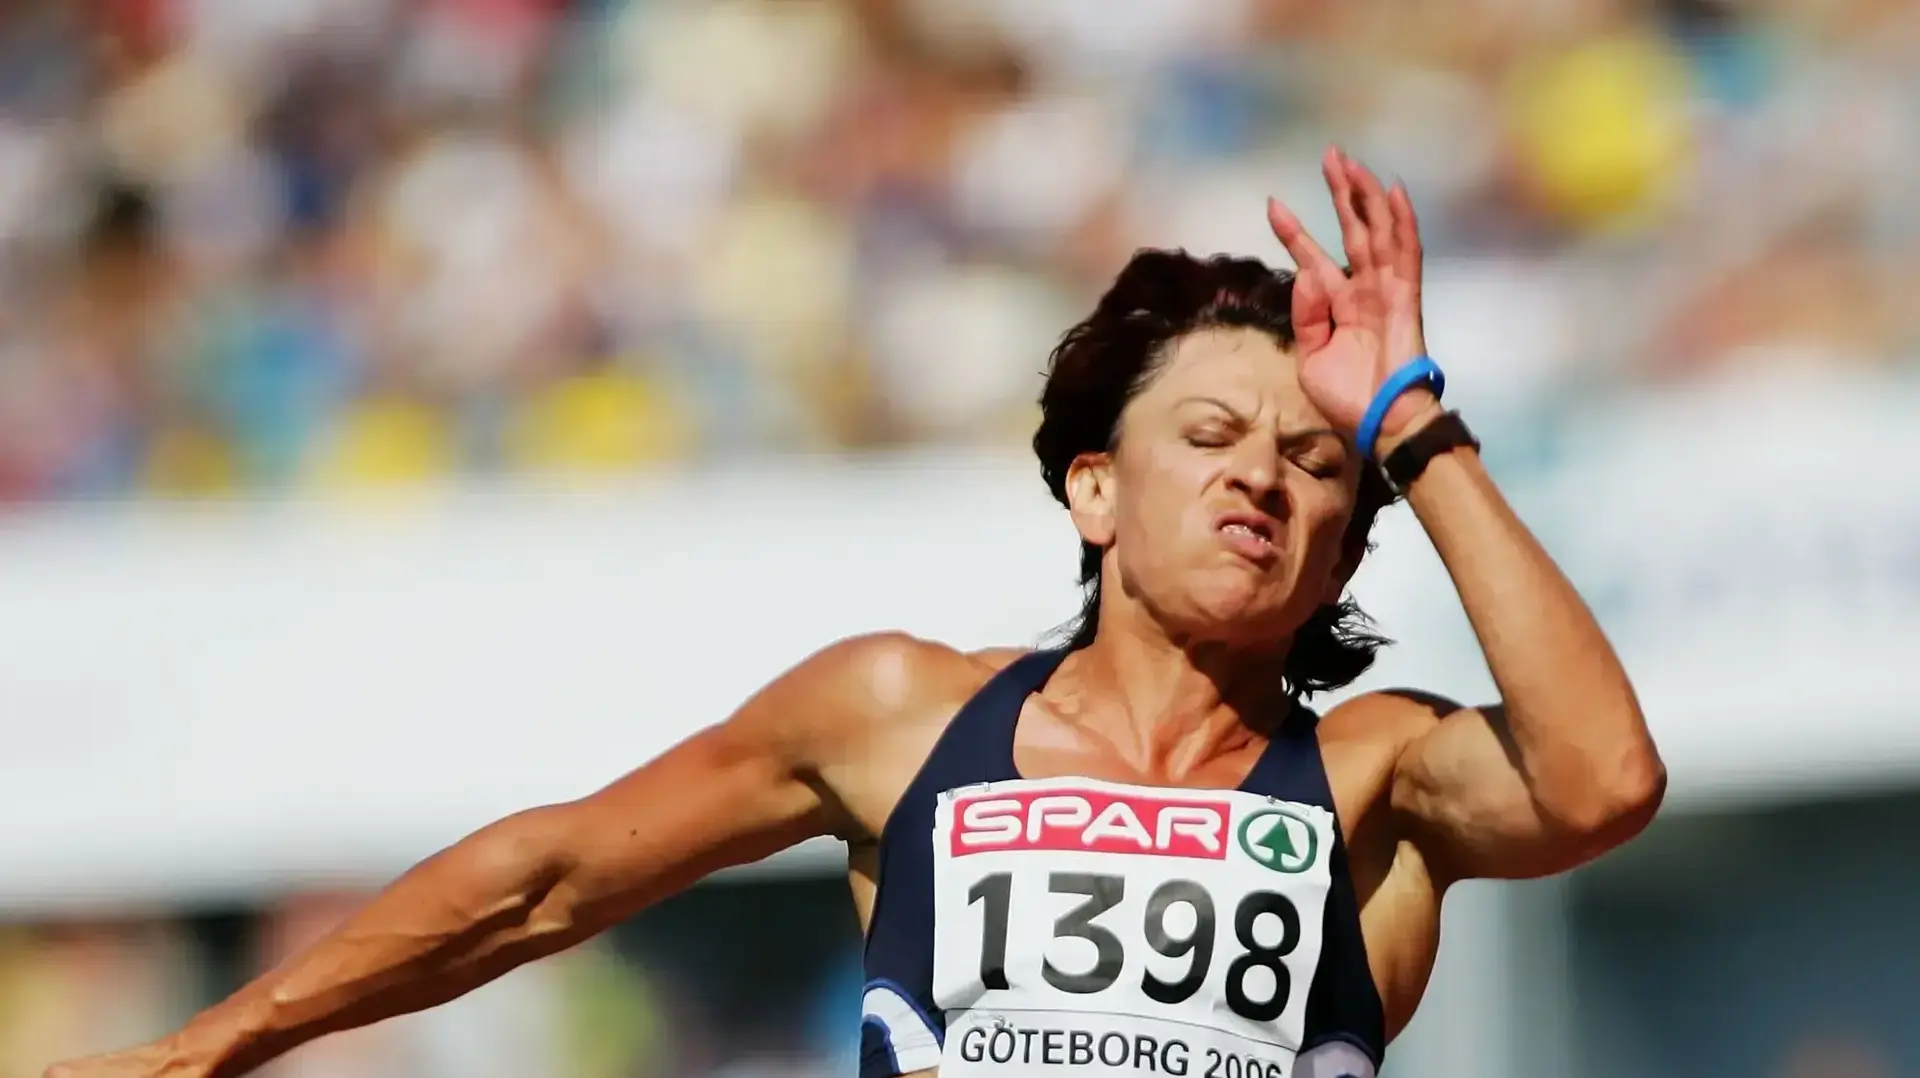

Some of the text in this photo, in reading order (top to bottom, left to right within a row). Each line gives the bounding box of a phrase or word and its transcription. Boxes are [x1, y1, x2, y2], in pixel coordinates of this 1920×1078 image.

[960, 796, 1223, 853] SPAR
[967, 871, 1301, 1021] 1398
[960, 1022, 1189, 1077] GÖTEBORG
